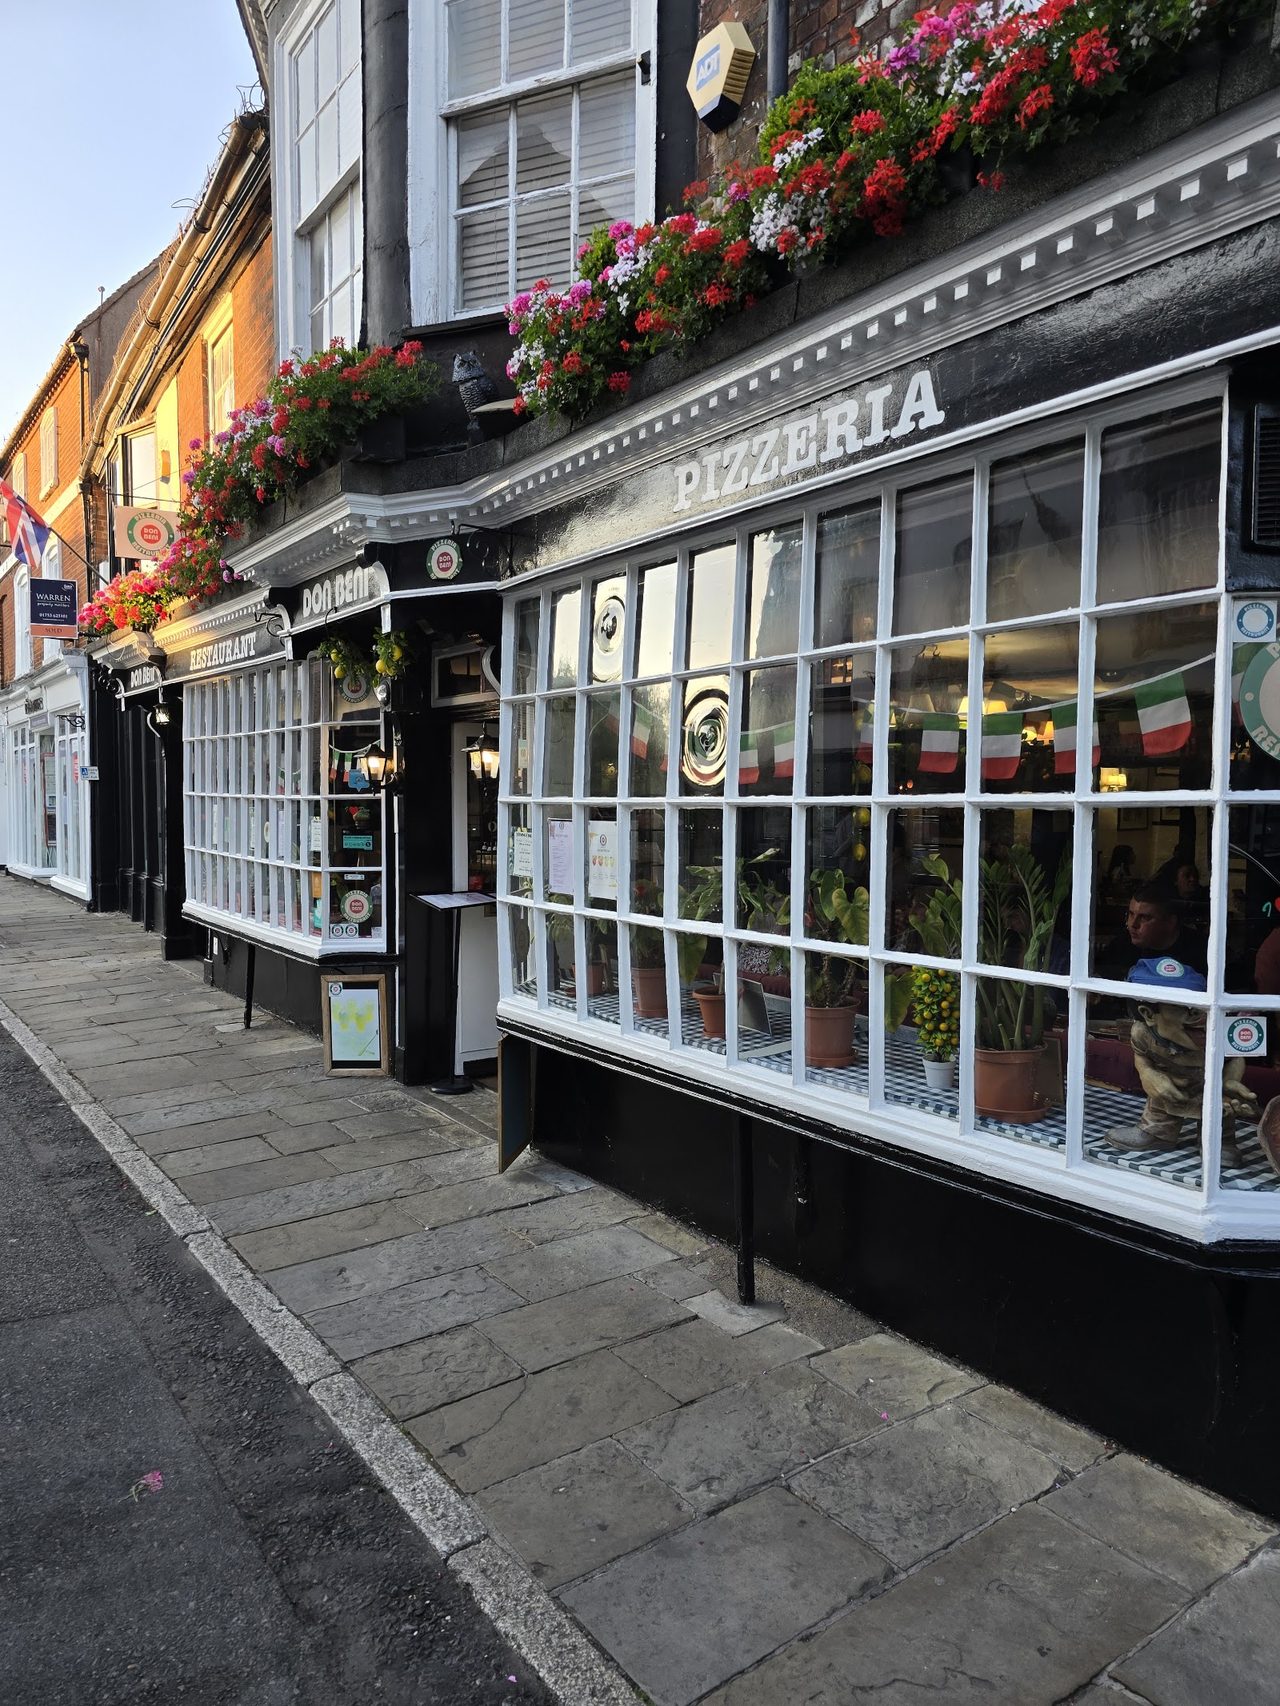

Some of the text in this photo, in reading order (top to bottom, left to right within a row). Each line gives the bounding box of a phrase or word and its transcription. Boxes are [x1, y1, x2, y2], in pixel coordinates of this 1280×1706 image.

[673, 370, 945, 513] PIZZERIA
[431, 539, 457, 551] PIZZERIA
[36, 593, 71, 602] WARREN
[303, 566, 369, 618] DON BENI
[189, 631, 257, 671] RESTAURANT
